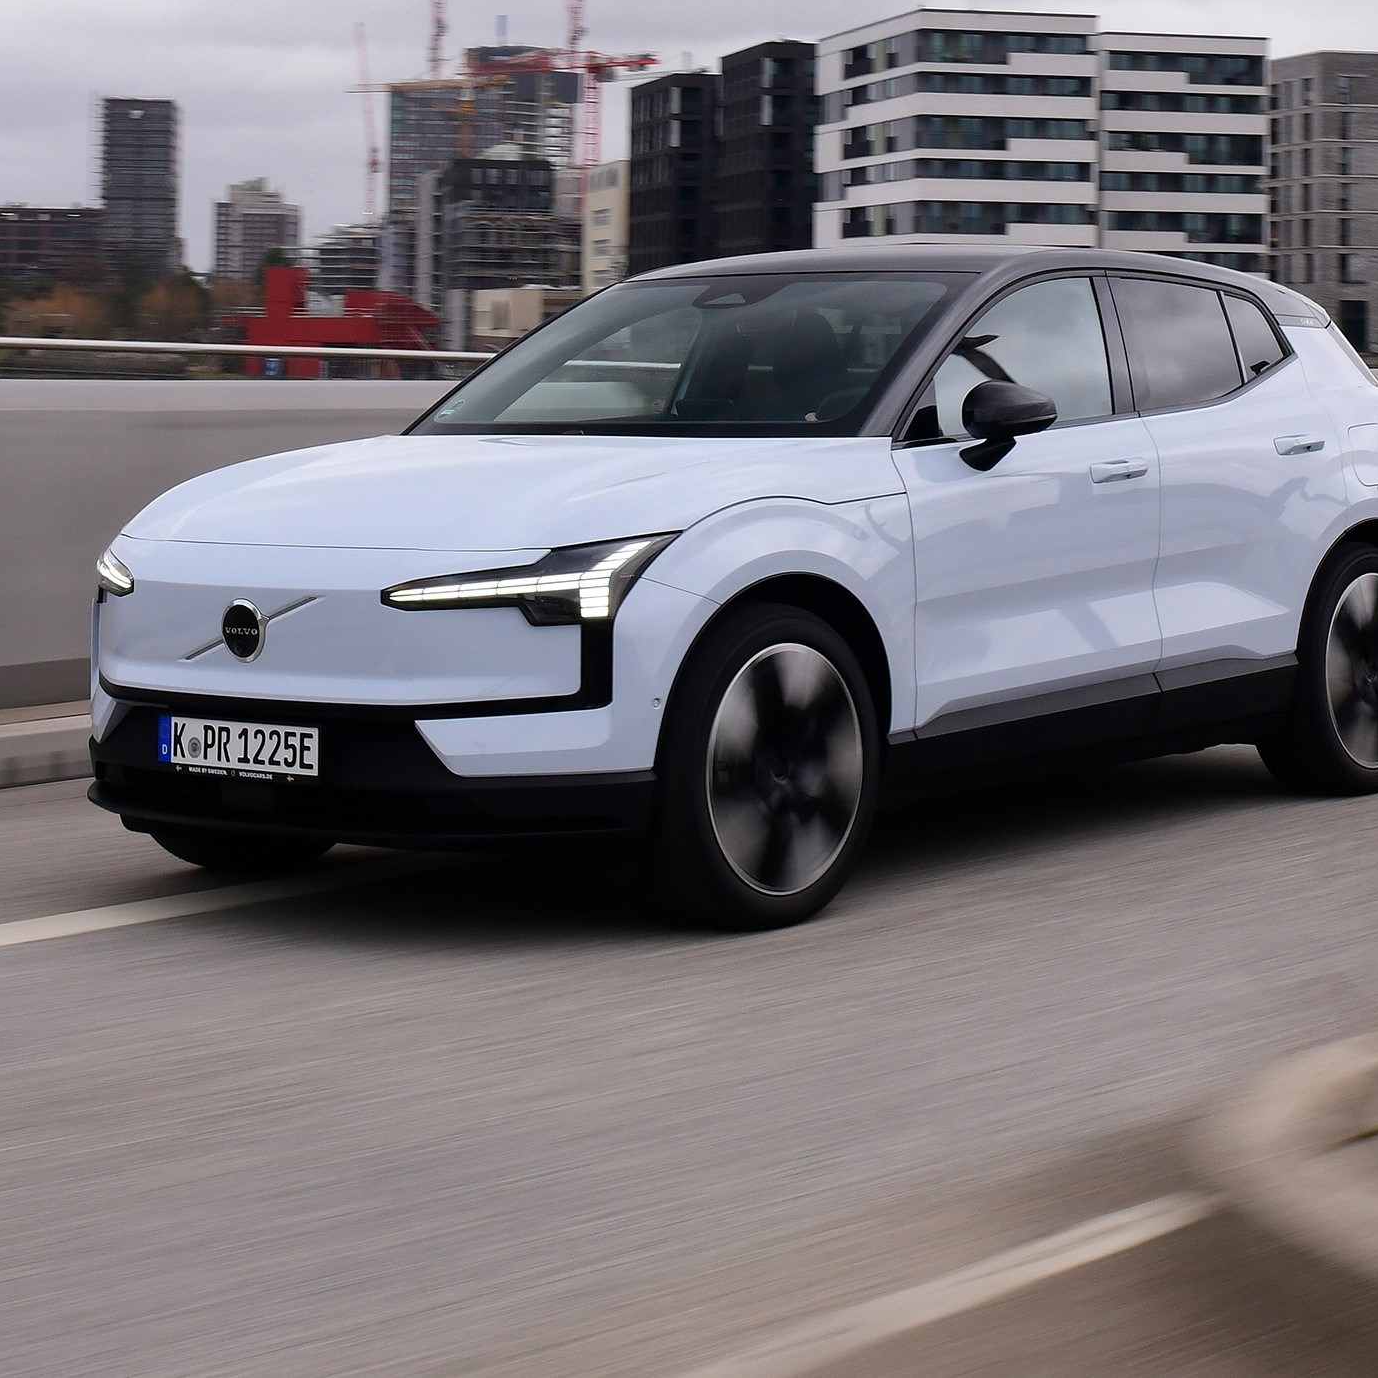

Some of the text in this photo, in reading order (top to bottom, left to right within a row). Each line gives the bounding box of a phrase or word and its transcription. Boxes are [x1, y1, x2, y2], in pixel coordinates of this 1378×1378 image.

[225, 627, 259, 636] VOLVO
[162, 744, 168, 755] D
[173, 722, 314, 770] K PR 1225E
